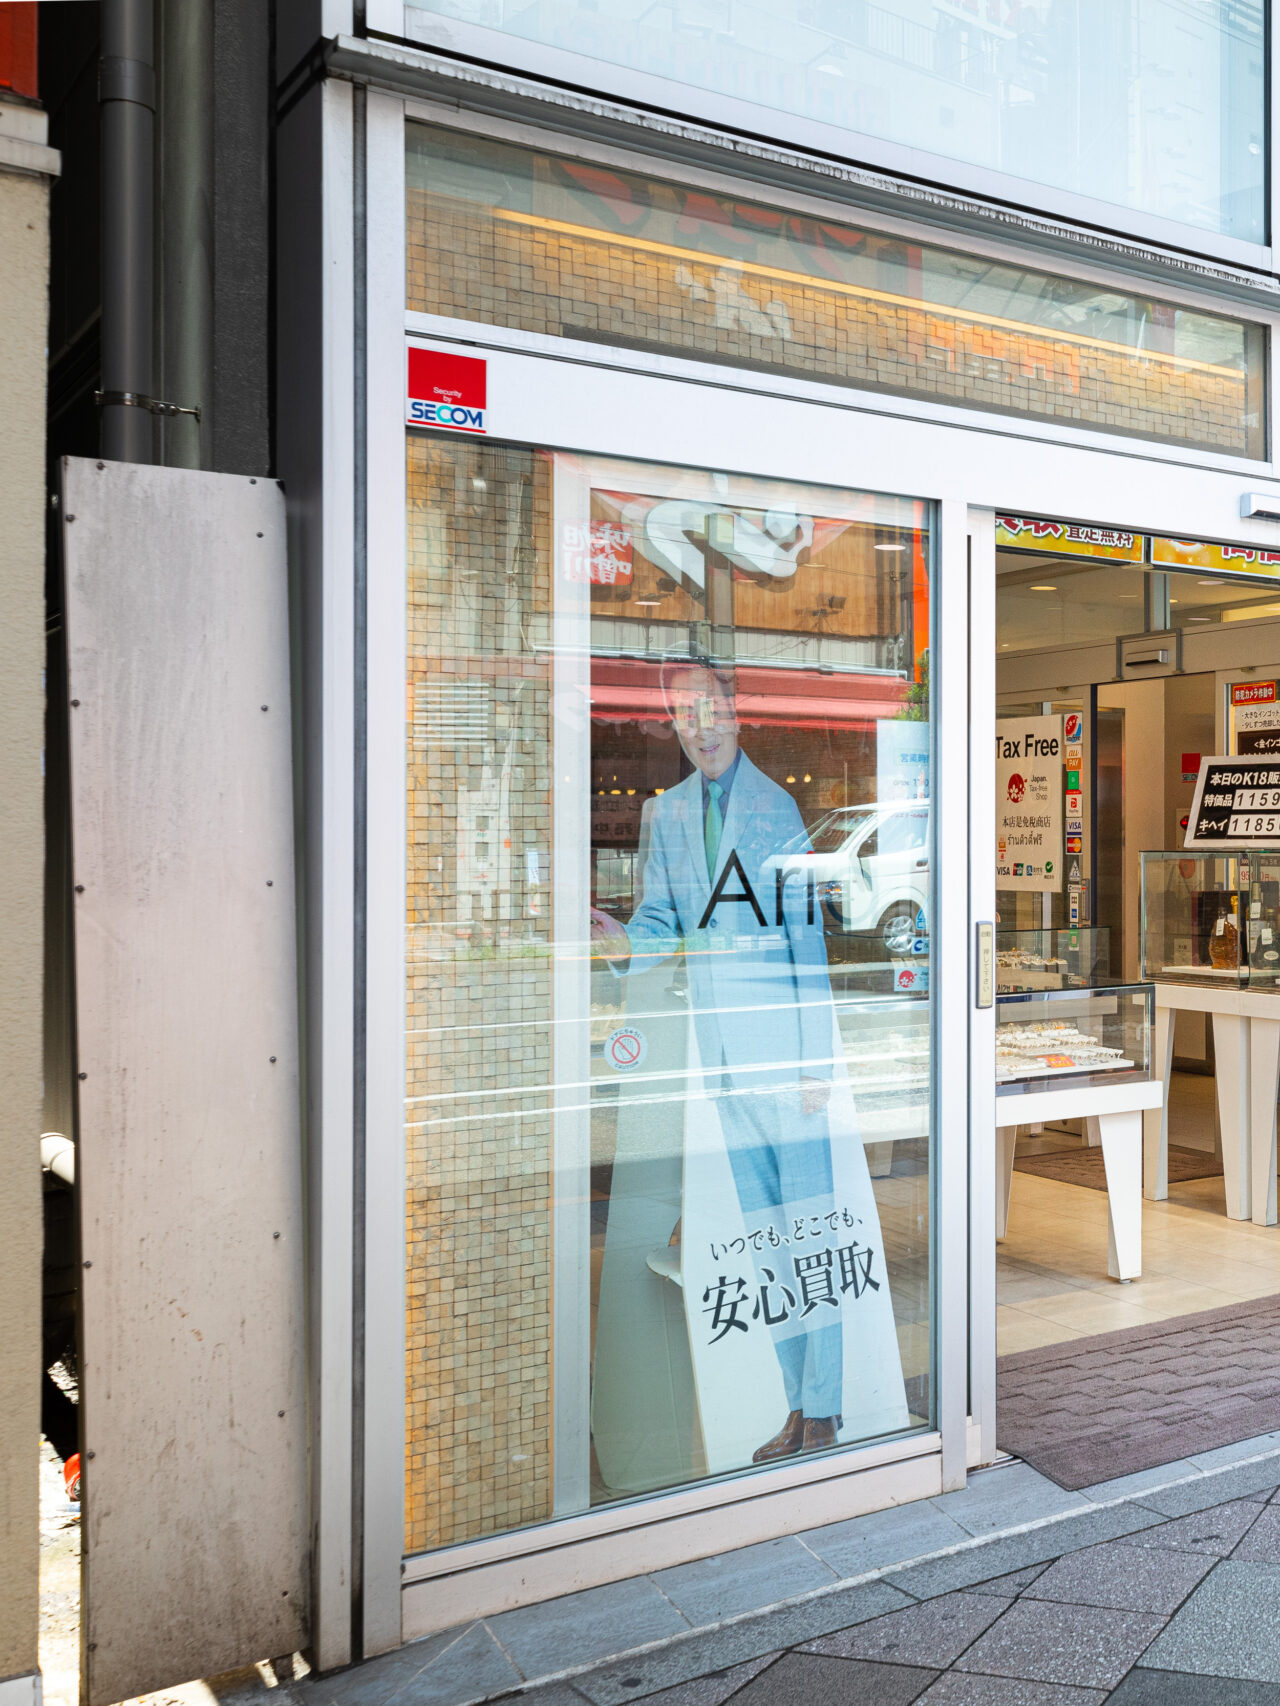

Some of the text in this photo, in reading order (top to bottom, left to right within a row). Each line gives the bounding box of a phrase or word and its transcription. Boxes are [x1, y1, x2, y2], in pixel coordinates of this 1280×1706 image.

[433, 387, 462, 398] Security
[411, 402, 482, 427] SECOM
[996, 733, 1059, 759] Tax Free
[1204, 794, 1233, 807] 特価品
[1068, 821, 1081, 830] VISA
[1199, 818, 1229, 832] キヘイ
[996, 866, 1011, 876] VISA
[711, 1207, 863, 1261] いつでも、どこでも、
[702, 1240, 881, 1345] 安心買取
